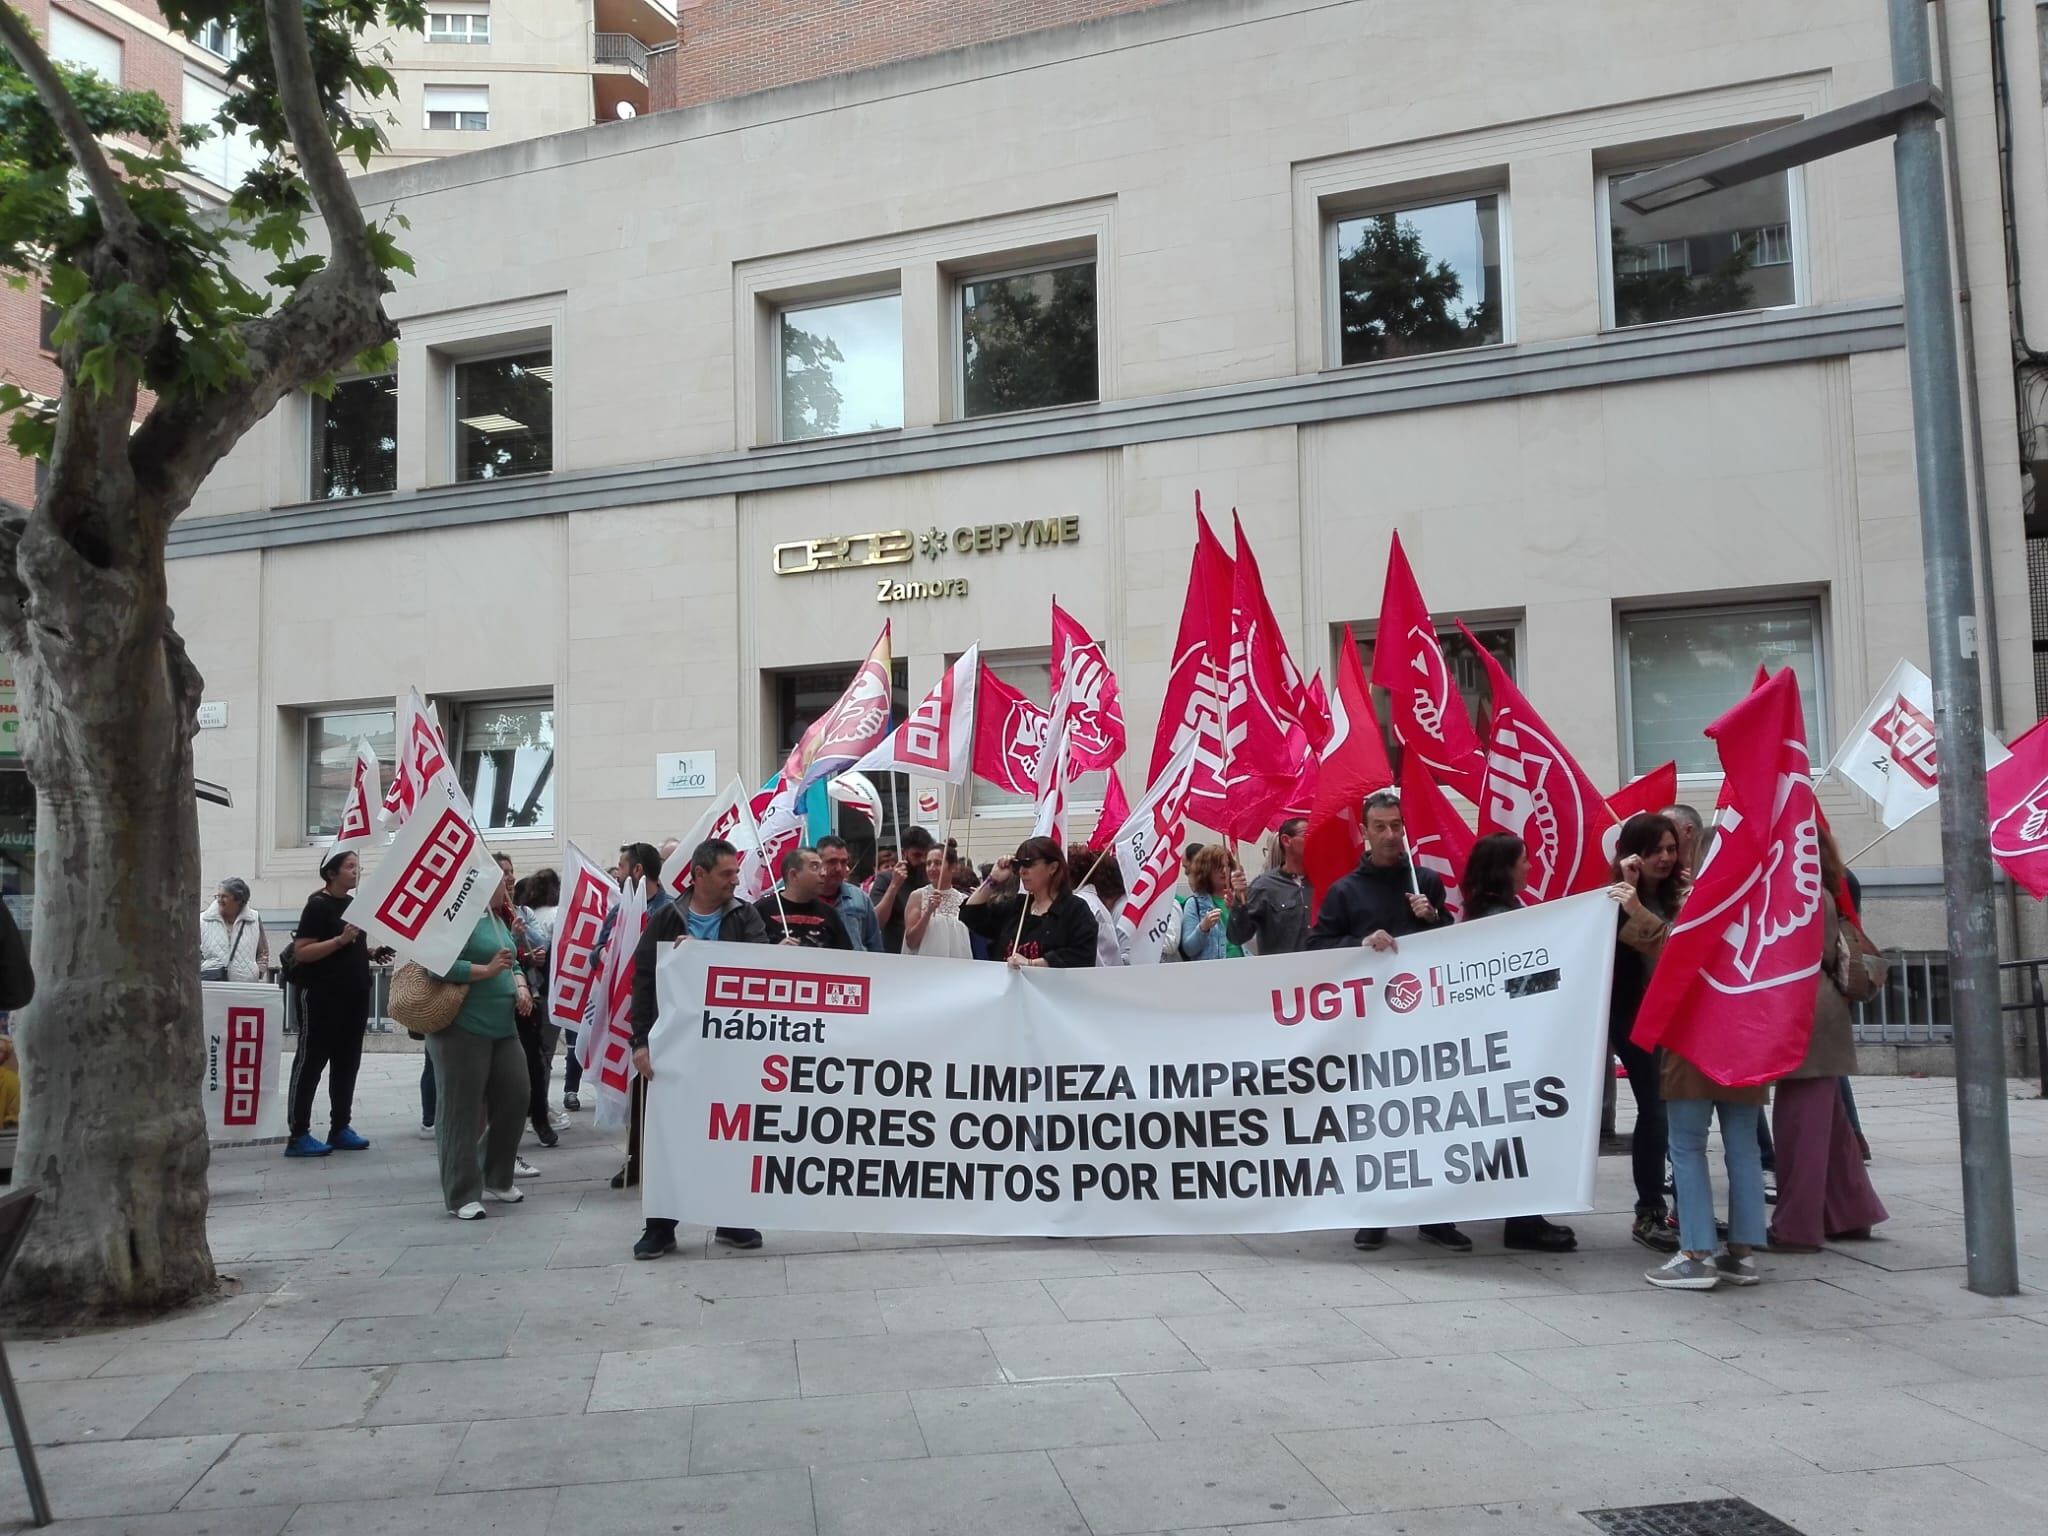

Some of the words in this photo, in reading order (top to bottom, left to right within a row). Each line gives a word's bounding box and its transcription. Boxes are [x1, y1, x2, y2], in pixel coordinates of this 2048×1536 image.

[953, 514, 1080, 552] CEPYME
[877, 577, 969, 602] Zamora
[387, 818, 469, 930] CCOO
[443, 868, 480, 923] Zamora
[714, 973, 819, 1006] CCOO
[1446, 947, 1550, 985] Limpieza
[1271, 976, 1374, 1026] UGT
[1449, 983, 1496, 1004] FeSMC
[701, 1010, 826, 1044] hábitat
[210, 1034, 221, 1092] Zamora
[231, 1015, 259, 1118] CCOO
[760, 1054, 933, 1099] SECTOR
[945, 1062, 1137, 1103] LIMPIEZA
[1149, 1030, 1512, 1101] IMPRESCINDIBLE
[708, 1102, 936, 1149] MEJORES
[949, 1107, 1268, 1152] CONDICIONES
[1283, 1076, 1569, 1146] LABORALES
[750, 1154, 1061, 1202] INCREMENTOS
[1073, 1162, 1158, 1202] POR
[1172, 1156, 1345, 1201] ENCIMA
[1355, 1149, 1433, 1194] DEL
[1444, 1136, 1530, 1185] SMI
